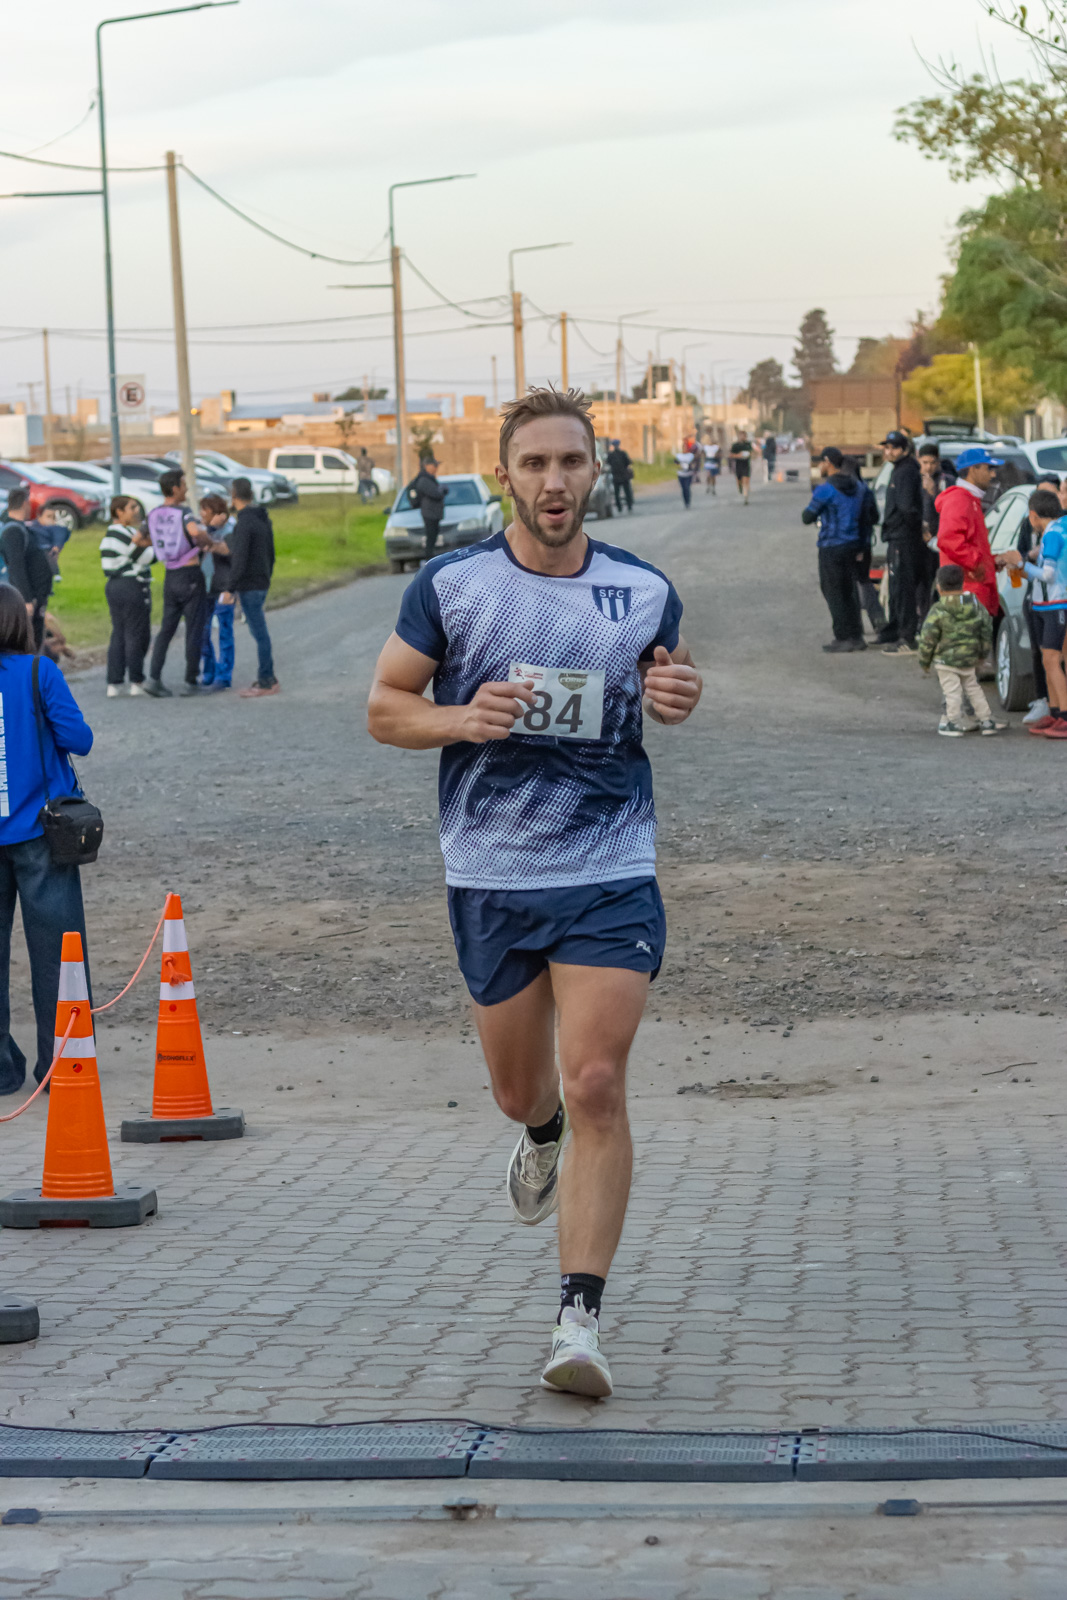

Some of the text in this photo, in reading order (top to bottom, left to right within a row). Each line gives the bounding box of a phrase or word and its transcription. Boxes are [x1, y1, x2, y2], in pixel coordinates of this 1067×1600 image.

[126, 387, 137, 402] E
[599, 589, 625, 599] SFC
[523, 691, 583, 733] 84
